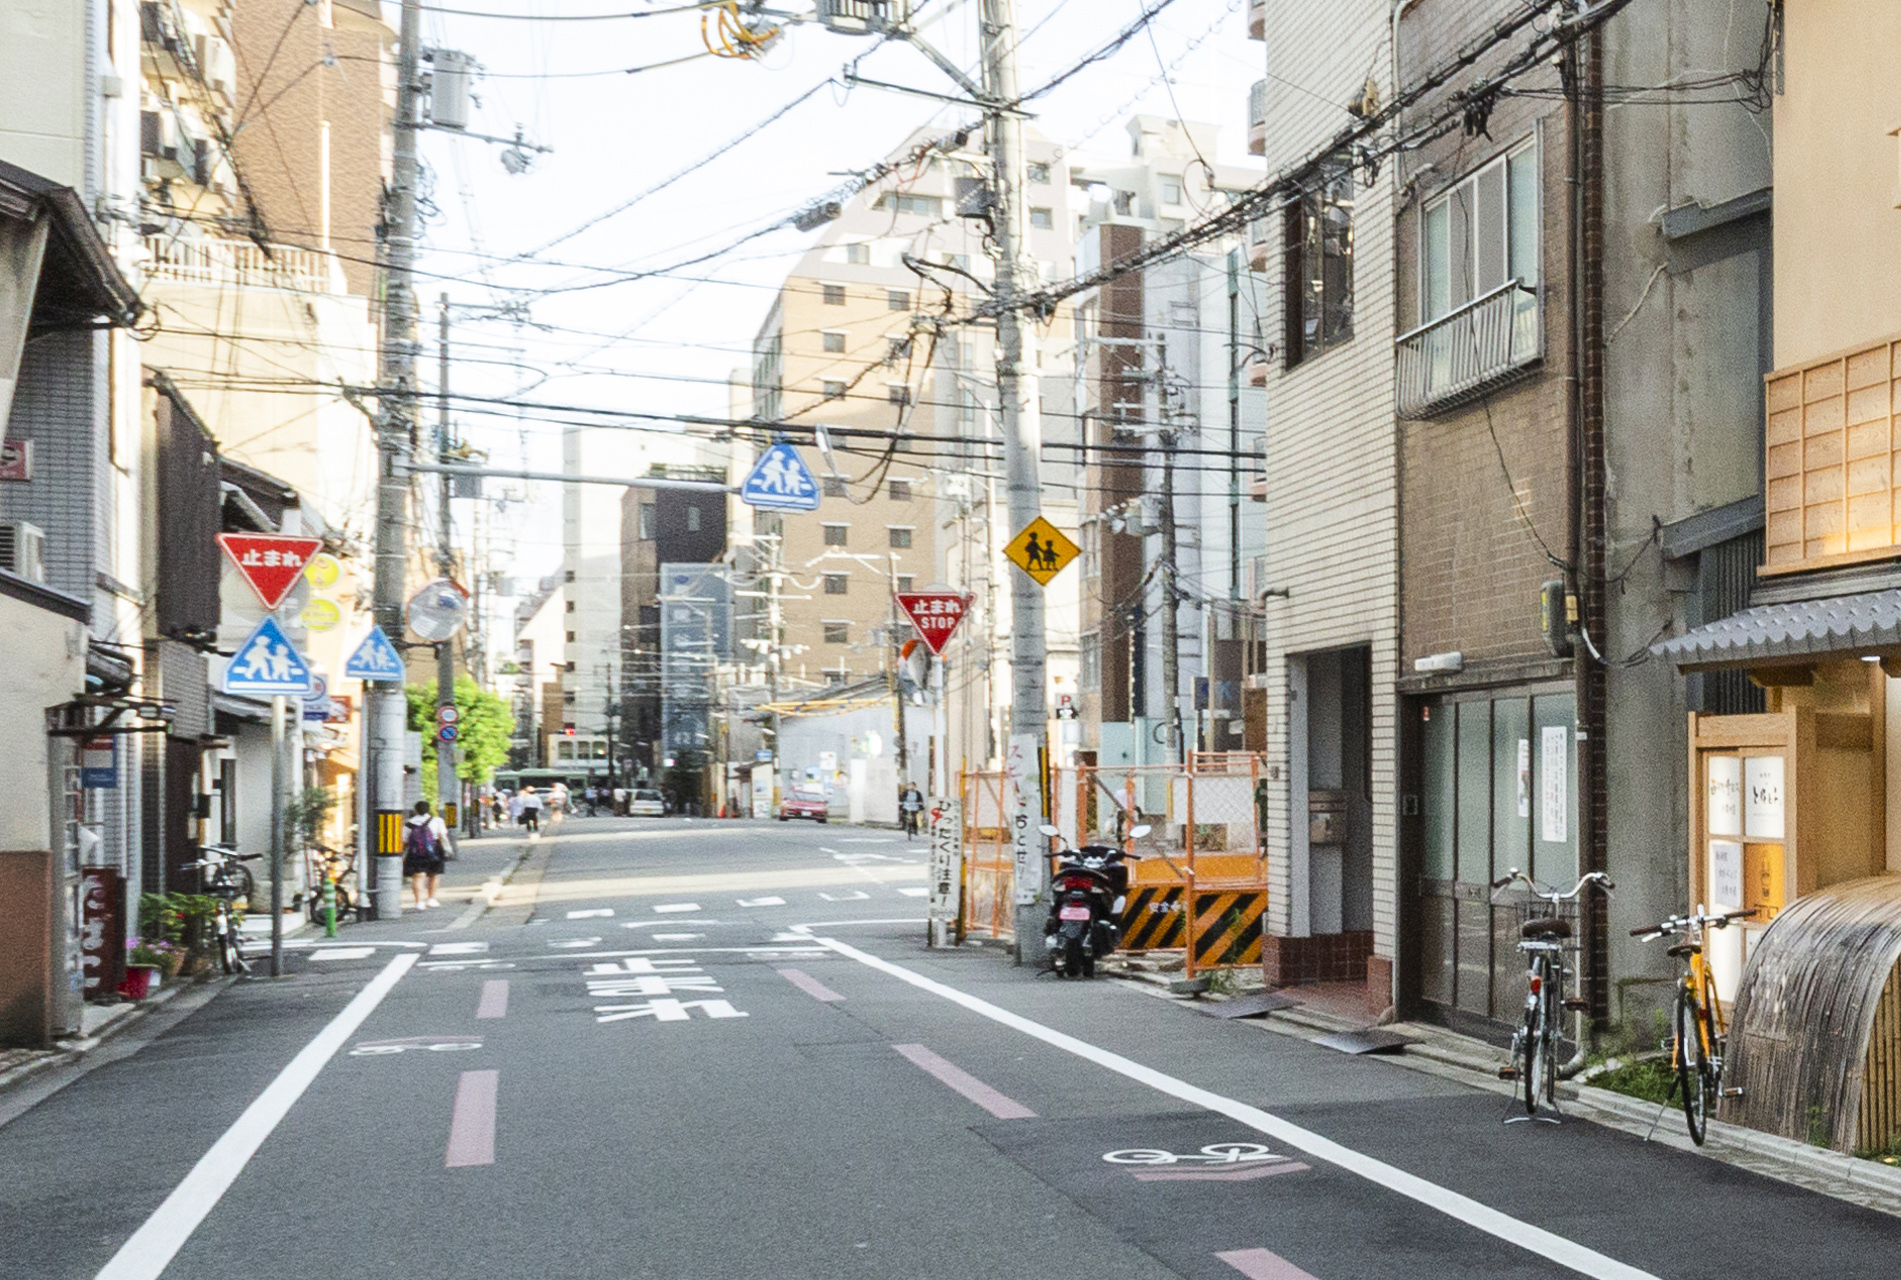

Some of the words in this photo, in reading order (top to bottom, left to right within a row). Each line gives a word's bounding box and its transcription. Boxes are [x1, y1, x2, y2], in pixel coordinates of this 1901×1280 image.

[241, 549, 303, 567] 止まれ
[913, 599, 961, 614] 止まれ
[921, 617, 955, 629] STOP
[1060, 694, 1071, 706] P
[584, 957, 749, 1022] 止まれ
